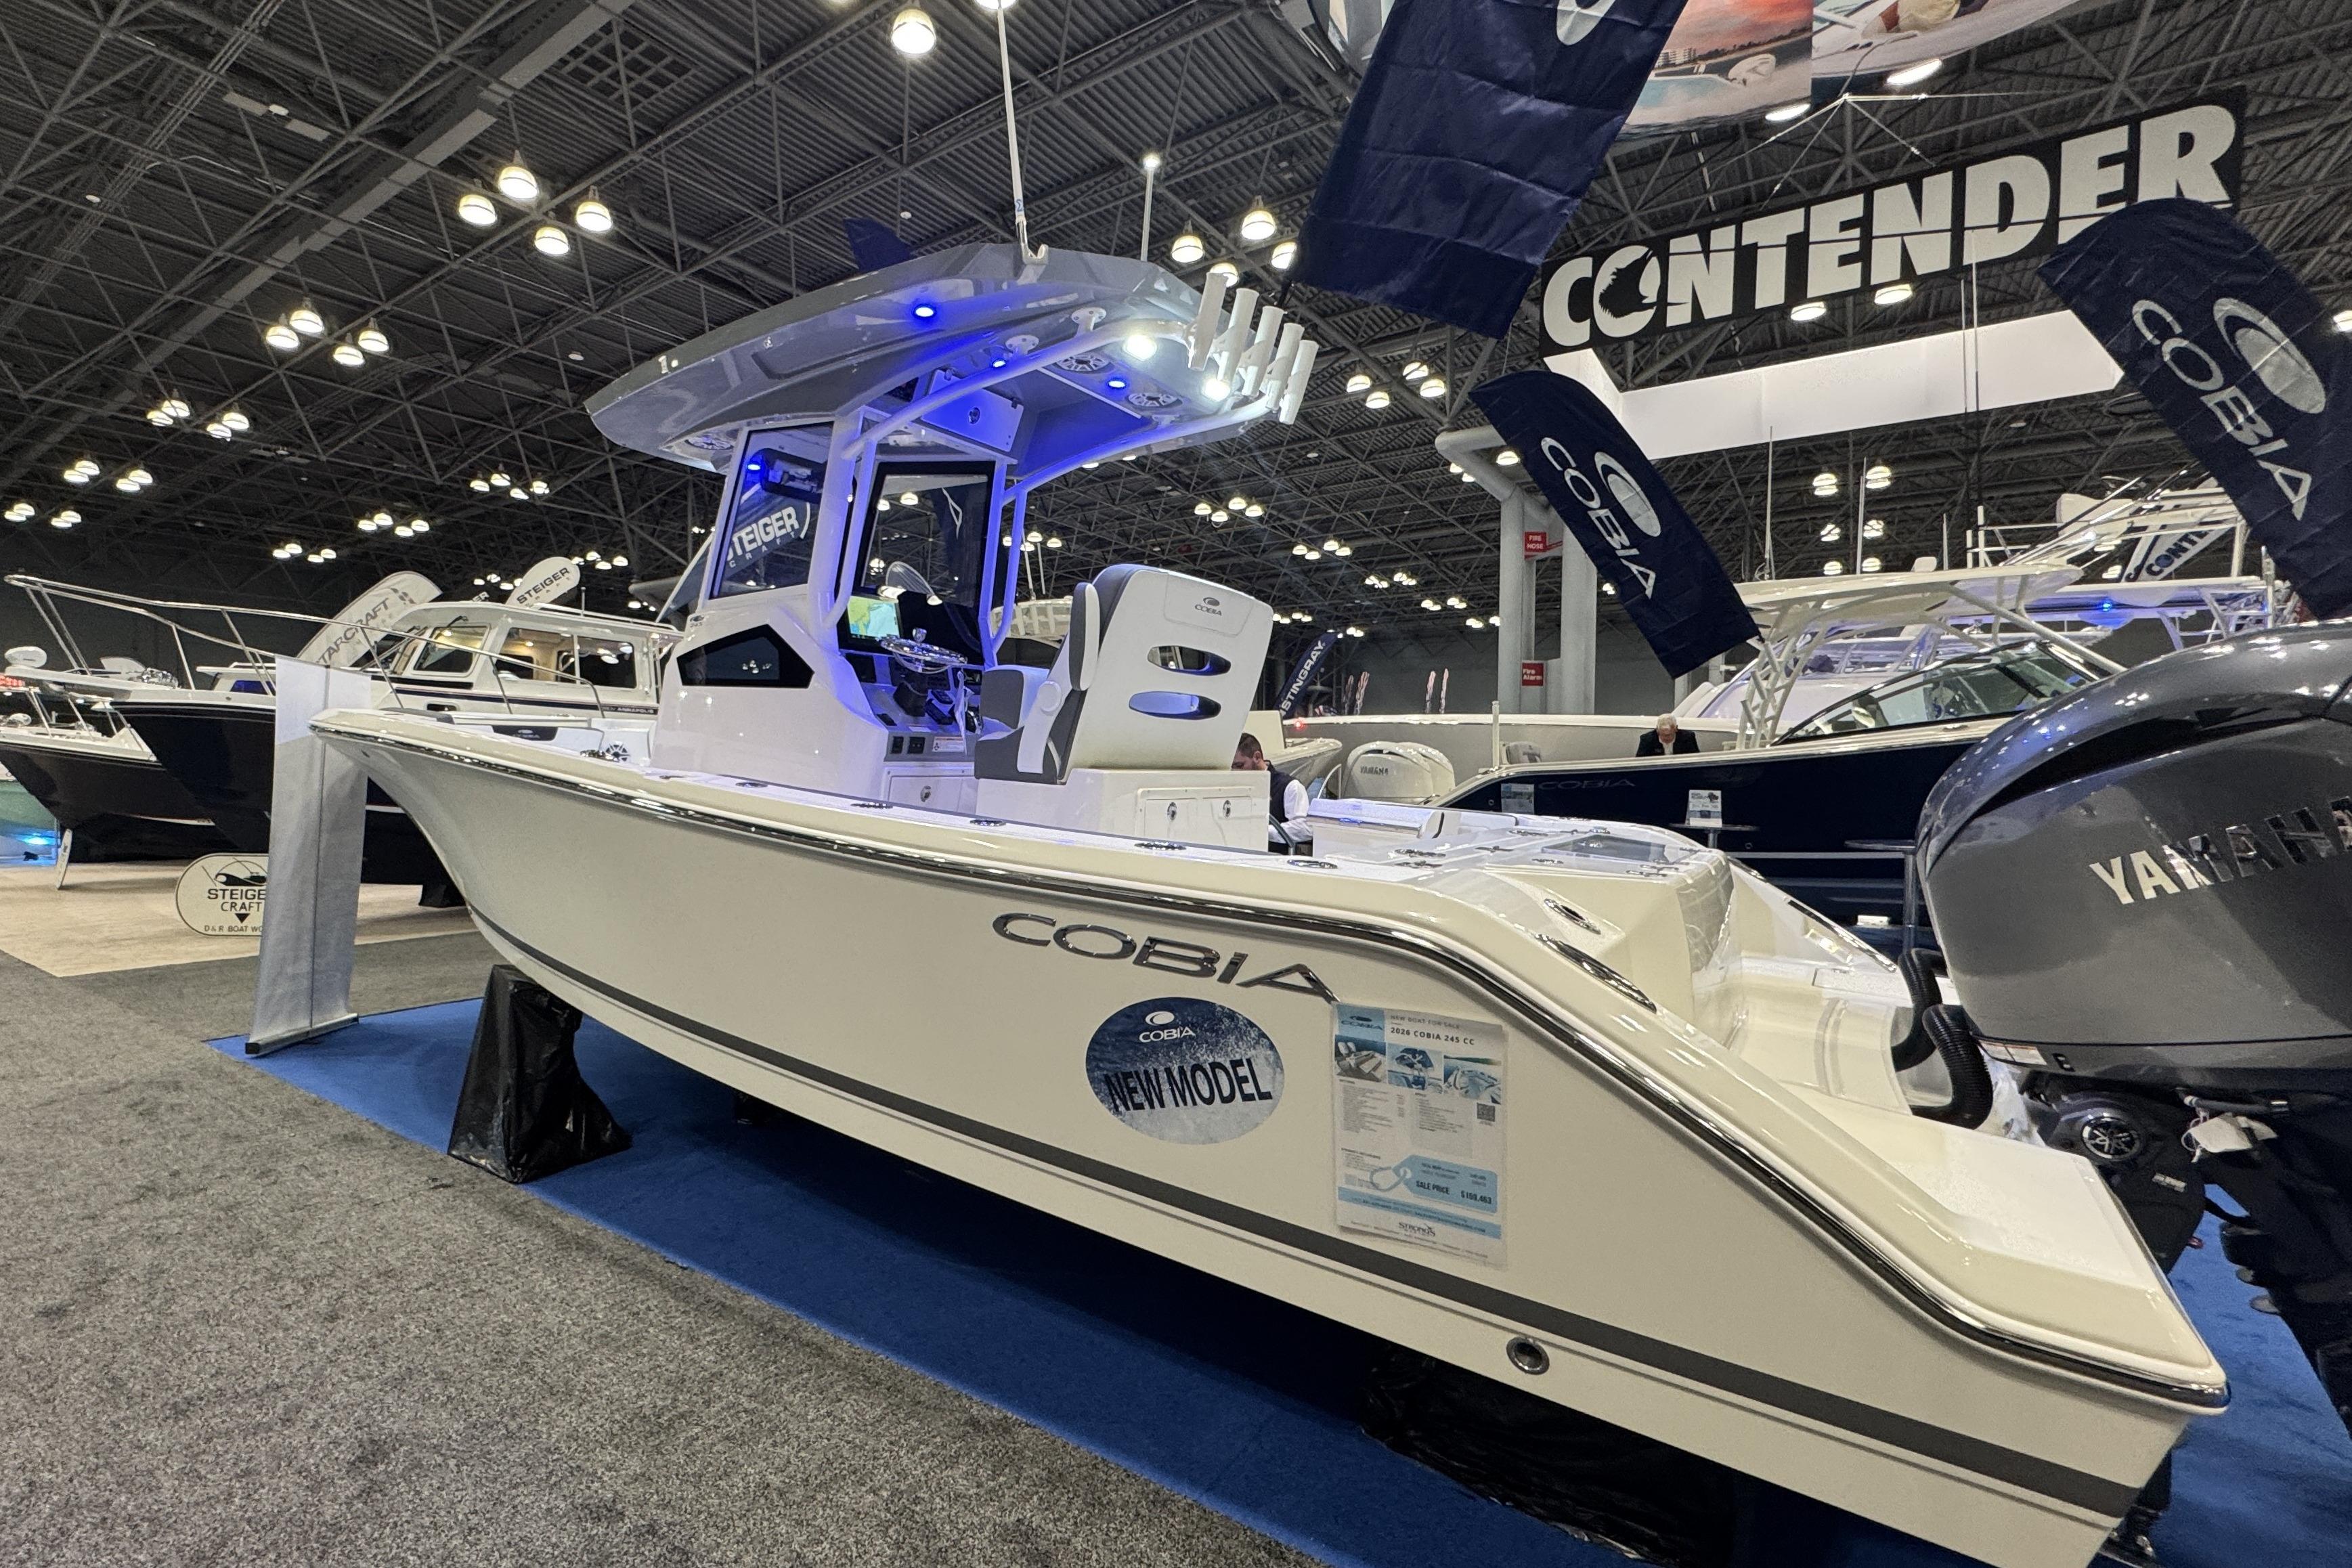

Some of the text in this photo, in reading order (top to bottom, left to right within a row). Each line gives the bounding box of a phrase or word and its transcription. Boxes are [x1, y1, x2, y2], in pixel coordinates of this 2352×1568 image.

[1543, 105, 2236, 346] CONTENDER
[2133, 300, 2311, 521] COBIA
[1541, 437, 1656, 599] COBIA
[517, 567, 570, 604] STEIGER
[1195, 604, 1222, 616] COBIA
[315, 597, 389, 663] TARCRAFT
[1280, 640, 1325, 716] STINGRAY
[1539, 779, 1636, 790] COBIA
[221, 902, 262, 912] CRAFT
[993, 913, 1341, 1004] COBIA
[1139, 1026, 1196, 1043] COBIA
[1341, 1020, 1383, 1030] COBIA
[1390, 1027, 1475, 1046] 2026 COBIA 245 CC
[1104, 1058, 1273, 1112] NEW MODEL
[1416, 1180, 1450, 1195] SALE PRICE
